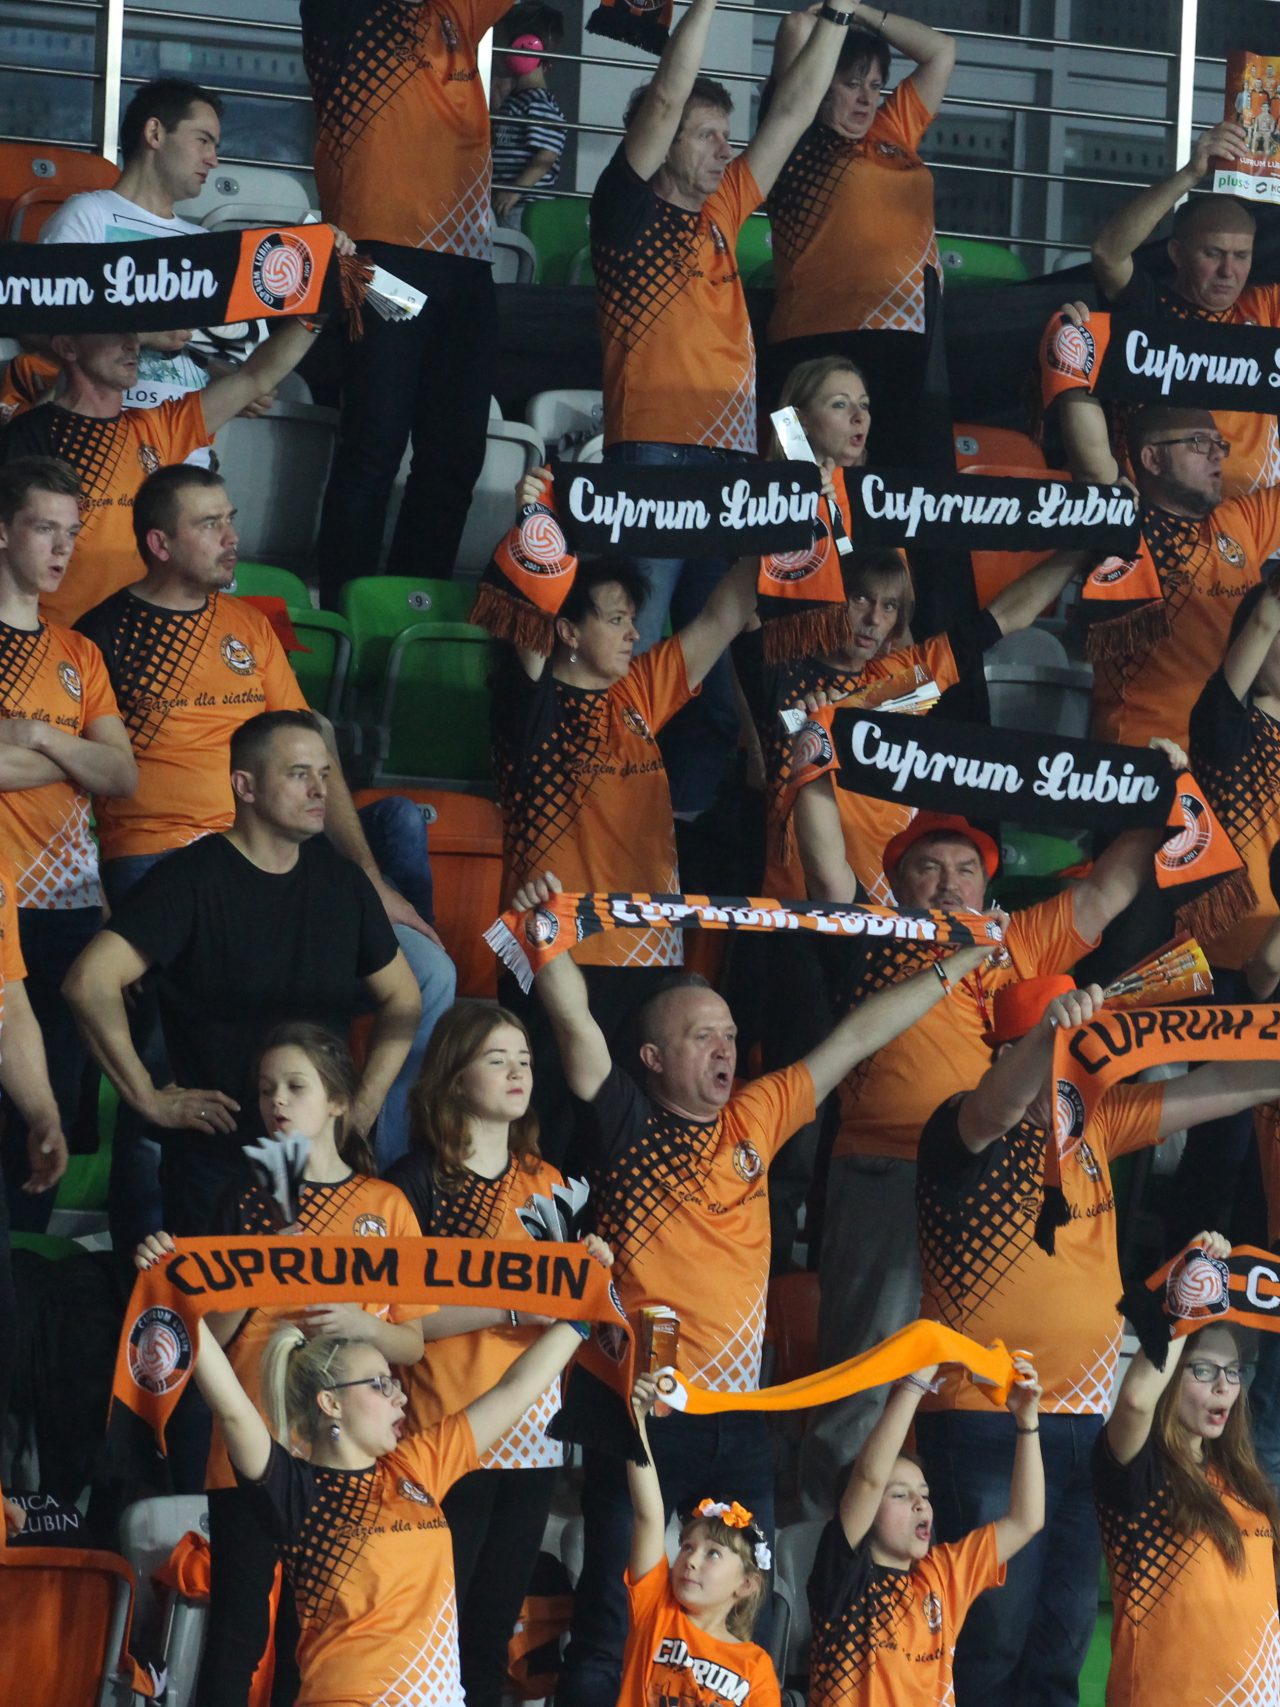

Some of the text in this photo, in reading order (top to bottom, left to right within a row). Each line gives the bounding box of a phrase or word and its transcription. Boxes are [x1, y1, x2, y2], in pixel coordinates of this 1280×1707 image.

[1218, 175, 1243, 188] plus
[102, 256, 218, 306] Lubin
[1126, 330, 1262, 395] Cuprum
[126, 389, 159, 403] LOS
[569, 477, 819, 543] Cuprum Lubin
[861, 474, 1136, 537] Cuprum Lubin
[56, 714, 79, 729] siatk
[194, 690, 216, 707] dla
[852, 720, 1159, 804] Cuprum Lubin
[1069, 1009, 1253, 1075] CUPRUM
[165, 1247, 591, 1301] CUPRUM LUBIN
[390, 1518, 409, 1534] dla
